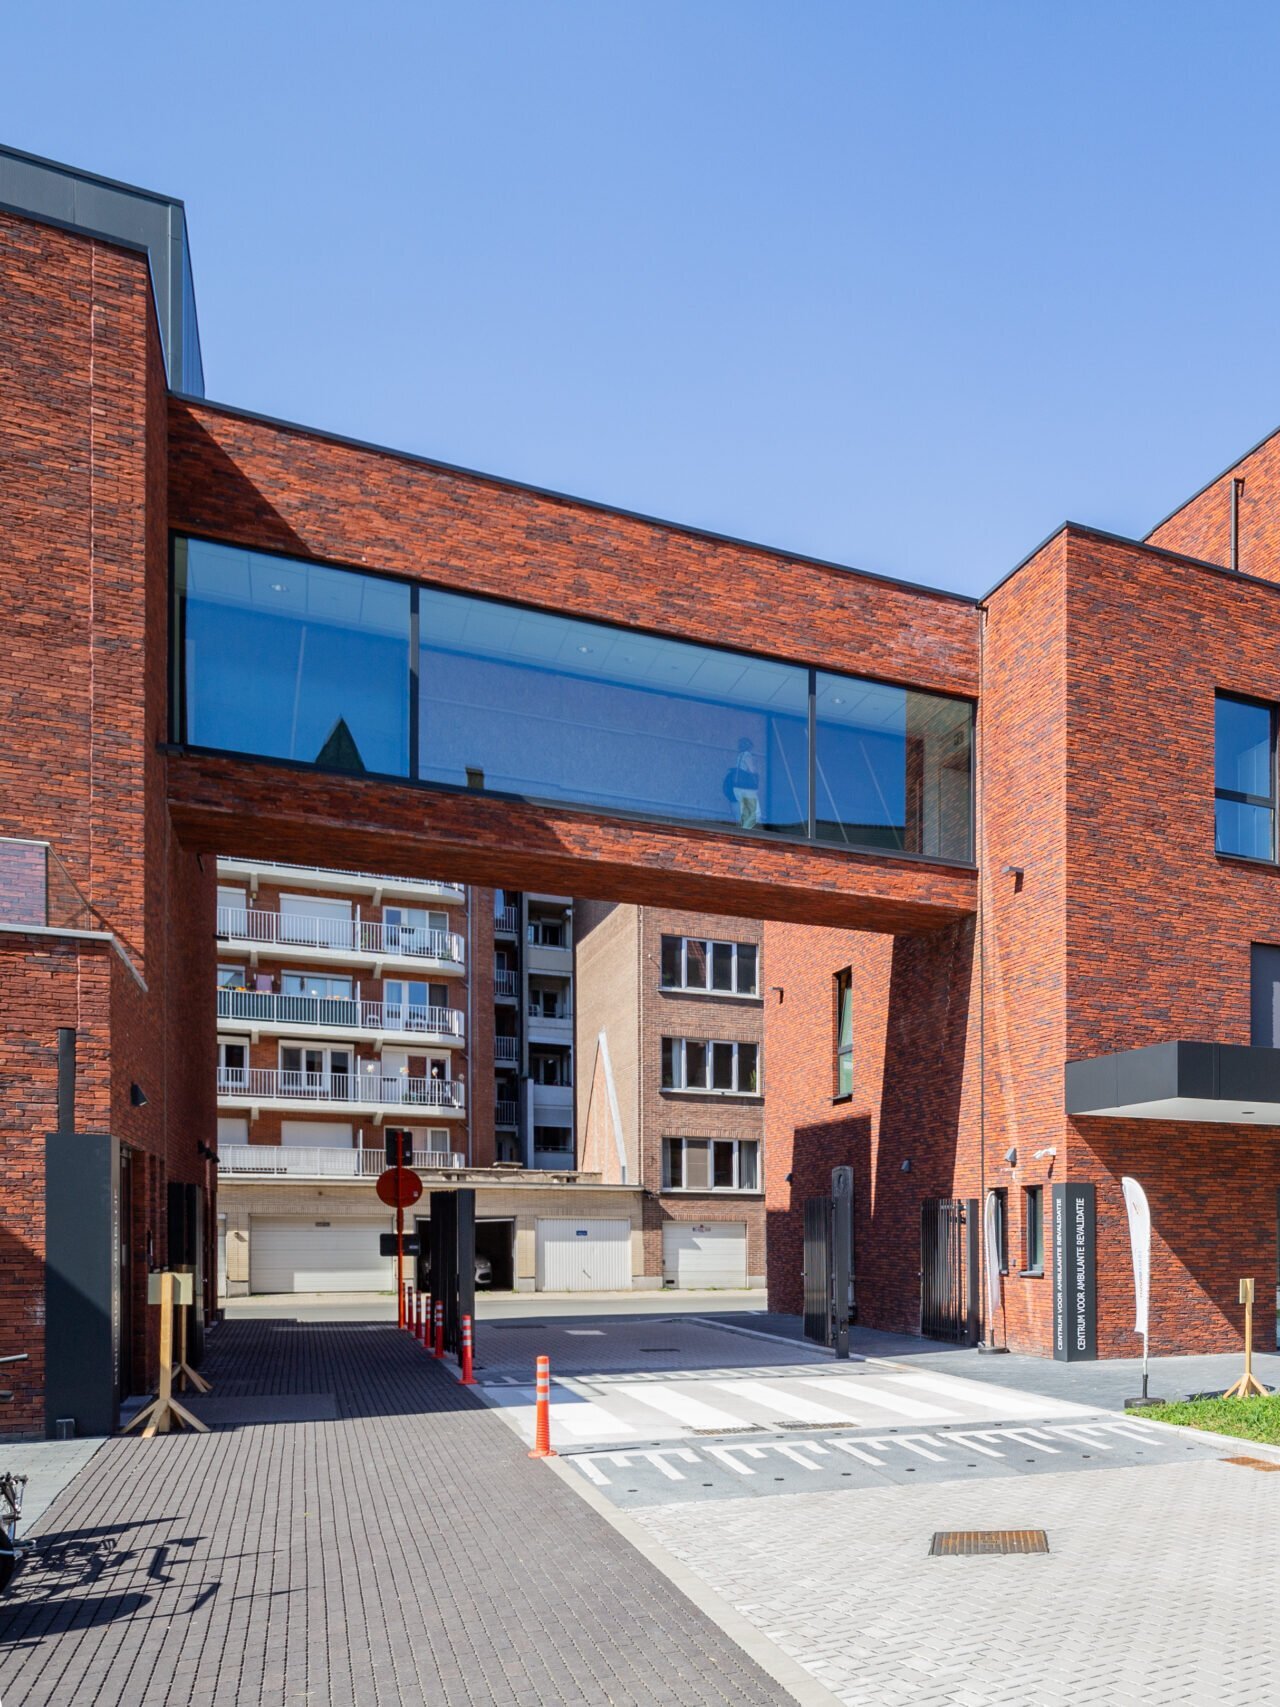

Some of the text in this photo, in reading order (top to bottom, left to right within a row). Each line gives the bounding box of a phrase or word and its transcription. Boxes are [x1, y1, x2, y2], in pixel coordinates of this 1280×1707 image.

[1076, 1198, 1086, 1350] CENTRUM VOOR AMBULANTE REVALIDATIE
